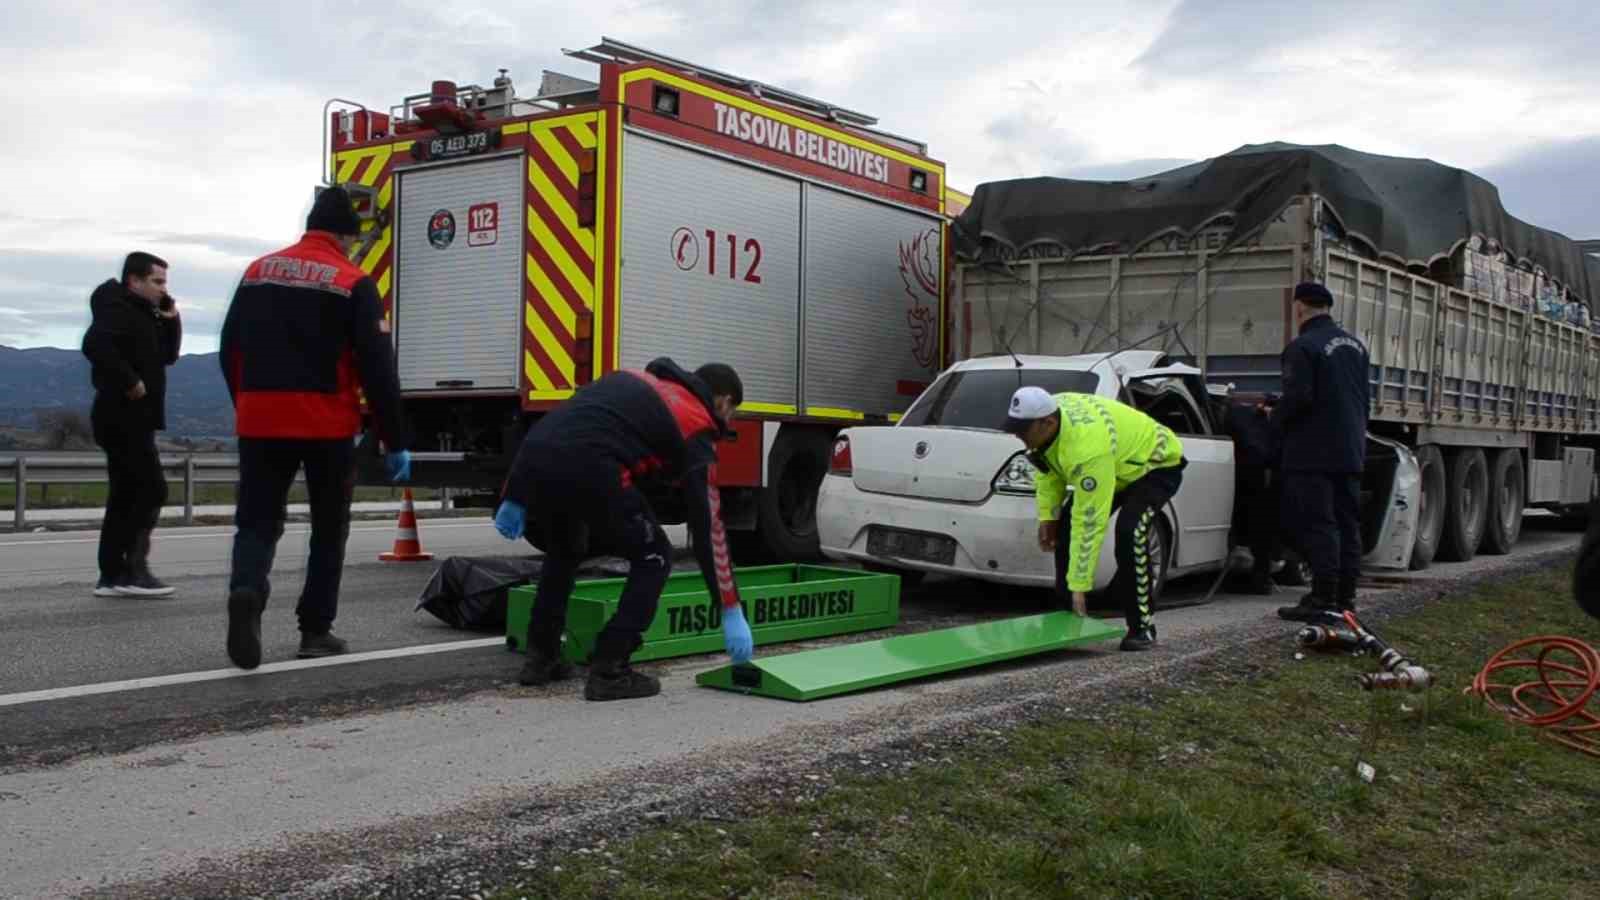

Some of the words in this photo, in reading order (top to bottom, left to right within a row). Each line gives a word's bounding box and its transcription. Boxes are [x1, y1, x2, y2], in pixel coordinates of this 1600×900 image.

[431, 139, 444, 154] 05
[467, 132, 487, 148] 373
[471, 207, 494, 230] 112
[705, 229, 761, 284] 112
[667, 600, 750, 636] TAŞO
